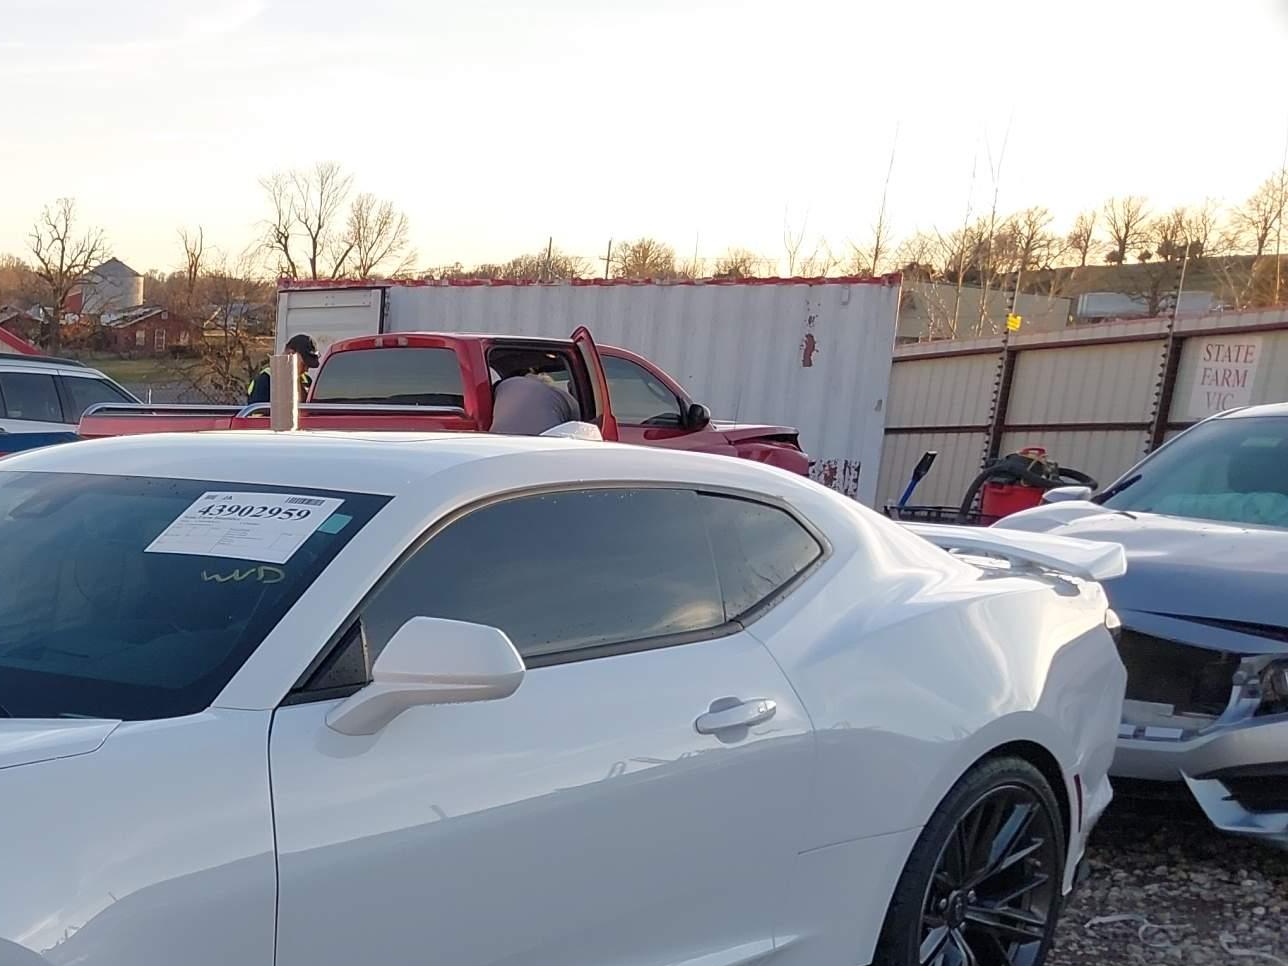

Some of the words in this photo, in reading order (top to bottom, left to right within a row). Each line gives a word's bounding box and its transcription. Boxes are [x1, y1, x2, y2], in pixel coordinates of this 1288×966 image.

[1203, 343, 1257, 363] STATE
[1200, 367, 1249, 388] FARM
[198, 504, 311, 521] 43902959
